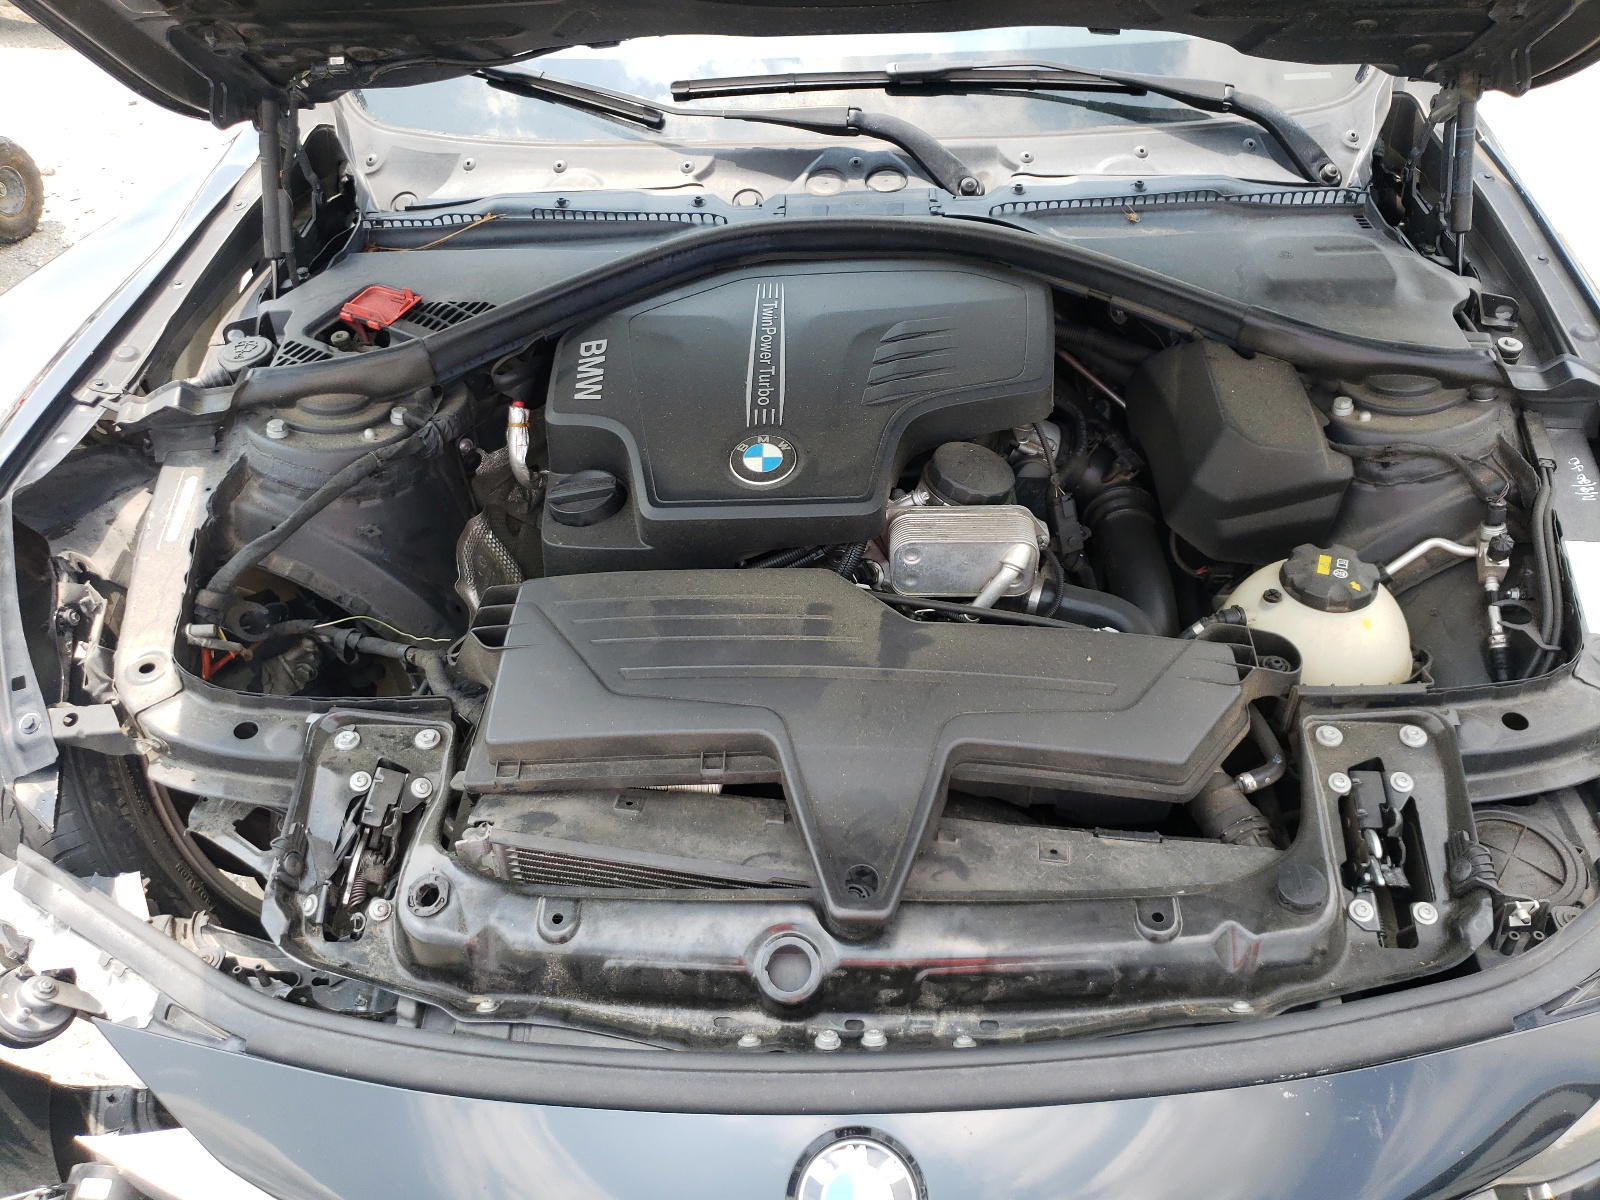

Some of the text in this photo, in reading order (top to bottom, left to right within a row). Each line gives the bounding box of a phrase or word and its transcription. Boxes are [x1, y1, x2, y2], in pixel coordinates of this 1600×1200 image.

[574, 339, 608, 400] BMW
[757, 301, 778, 406] TwinPower Turbo
[737, 435, 791, 453] BMW
